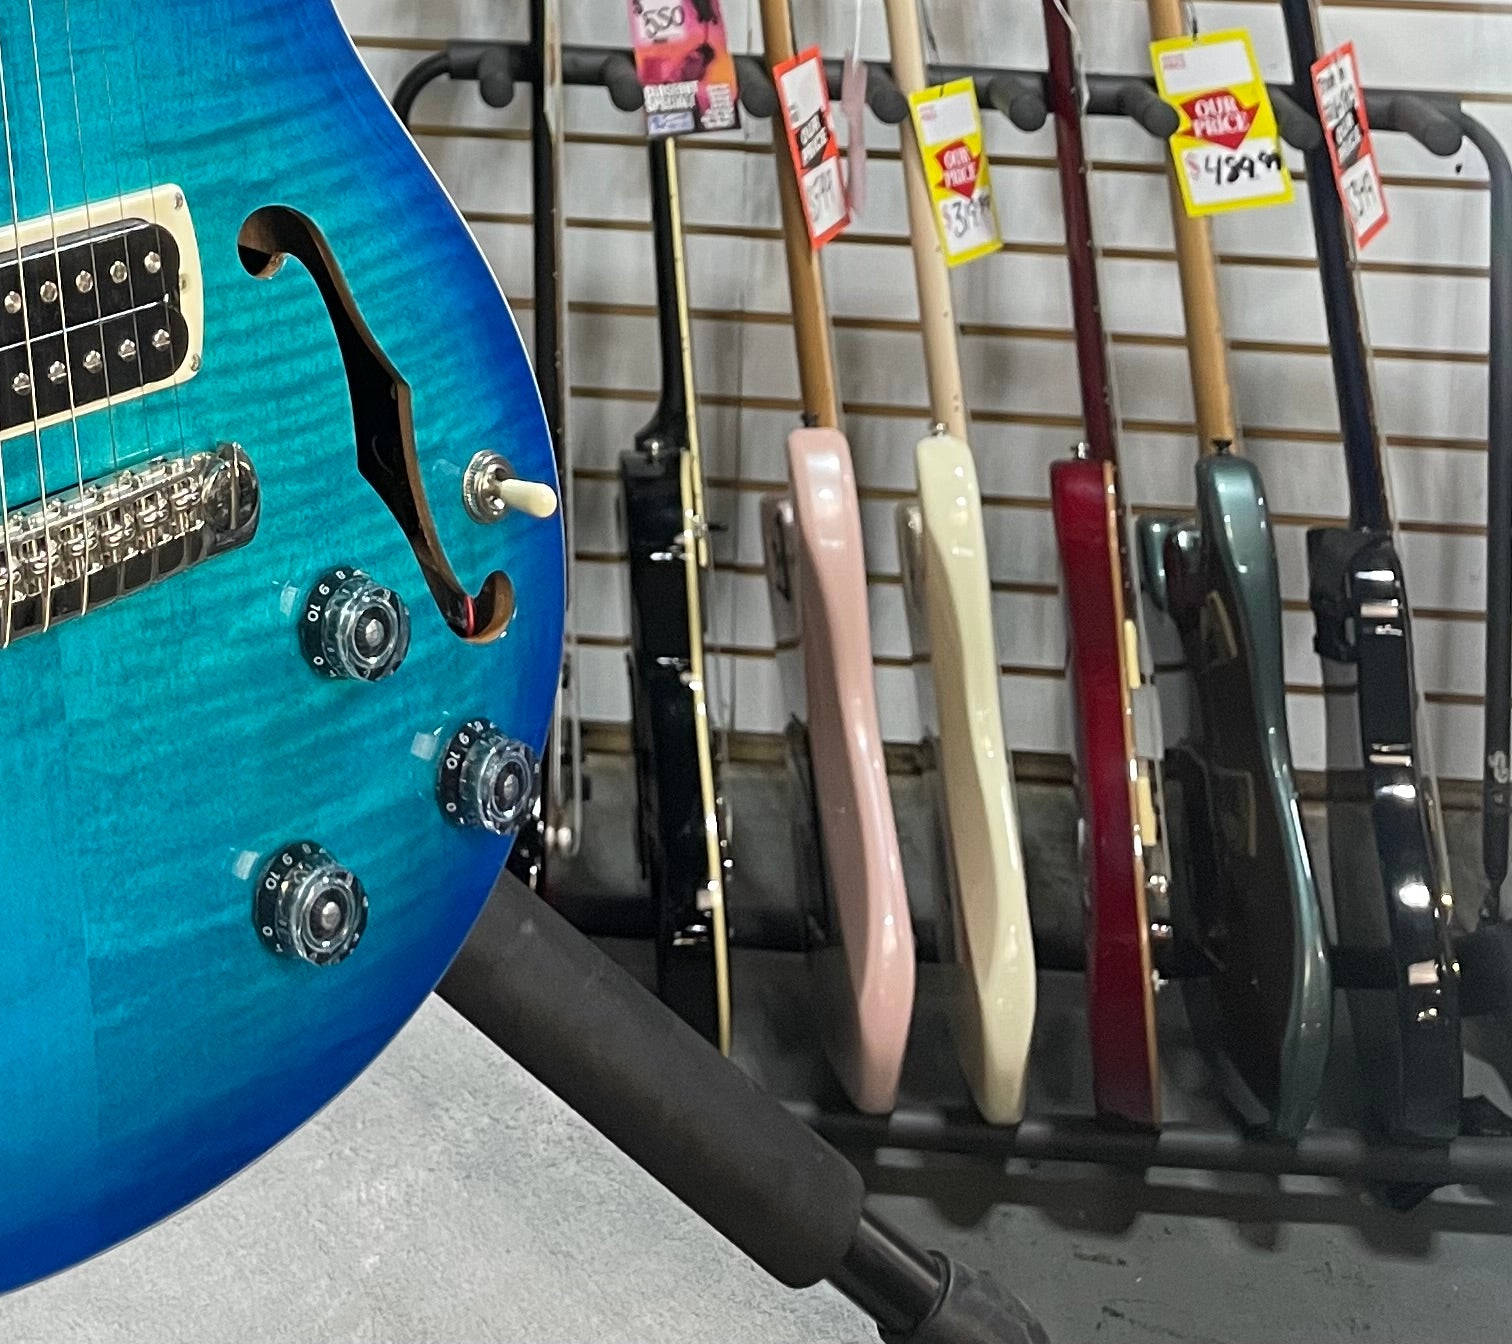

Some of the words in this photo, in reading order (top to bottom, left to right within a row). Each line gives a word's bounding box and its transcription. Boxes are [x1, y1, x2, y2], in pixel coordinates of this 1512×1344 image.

[1194, 94, 1239, 116] OUR
[1192, 111, 1250, 138] PRICE
[942, 145, 972, 169] OUR
